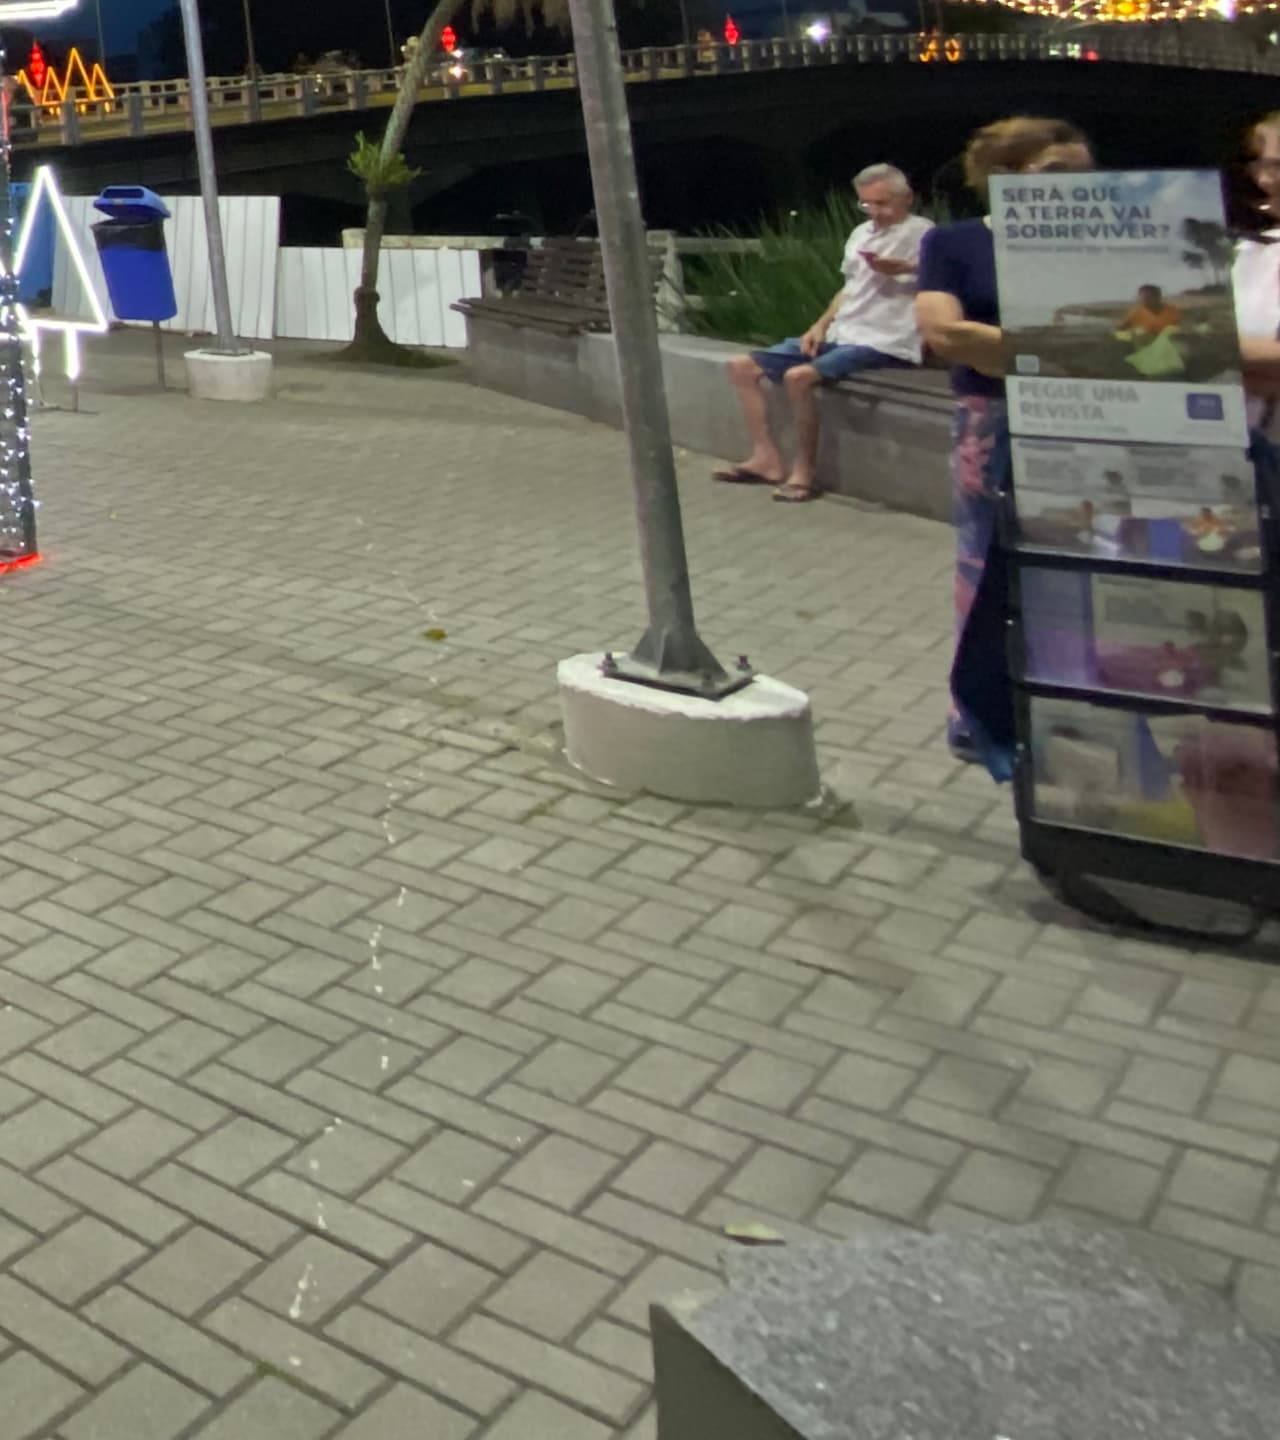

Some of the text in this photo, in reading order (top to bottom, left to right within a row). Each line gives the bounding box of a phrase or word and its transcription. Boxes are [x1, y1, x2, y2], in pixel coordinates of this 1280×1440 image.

[1002, 184, 1122, 203] SERÁ QUE
[1004, 205, 1152, 221] A TERRA VAI
[1005, 223, 1170, 240] SOBREVIVER?
[1018, 381, 1140, 403] PEGUE UMA
[1019, 401, 1105, 421] REVISTA
